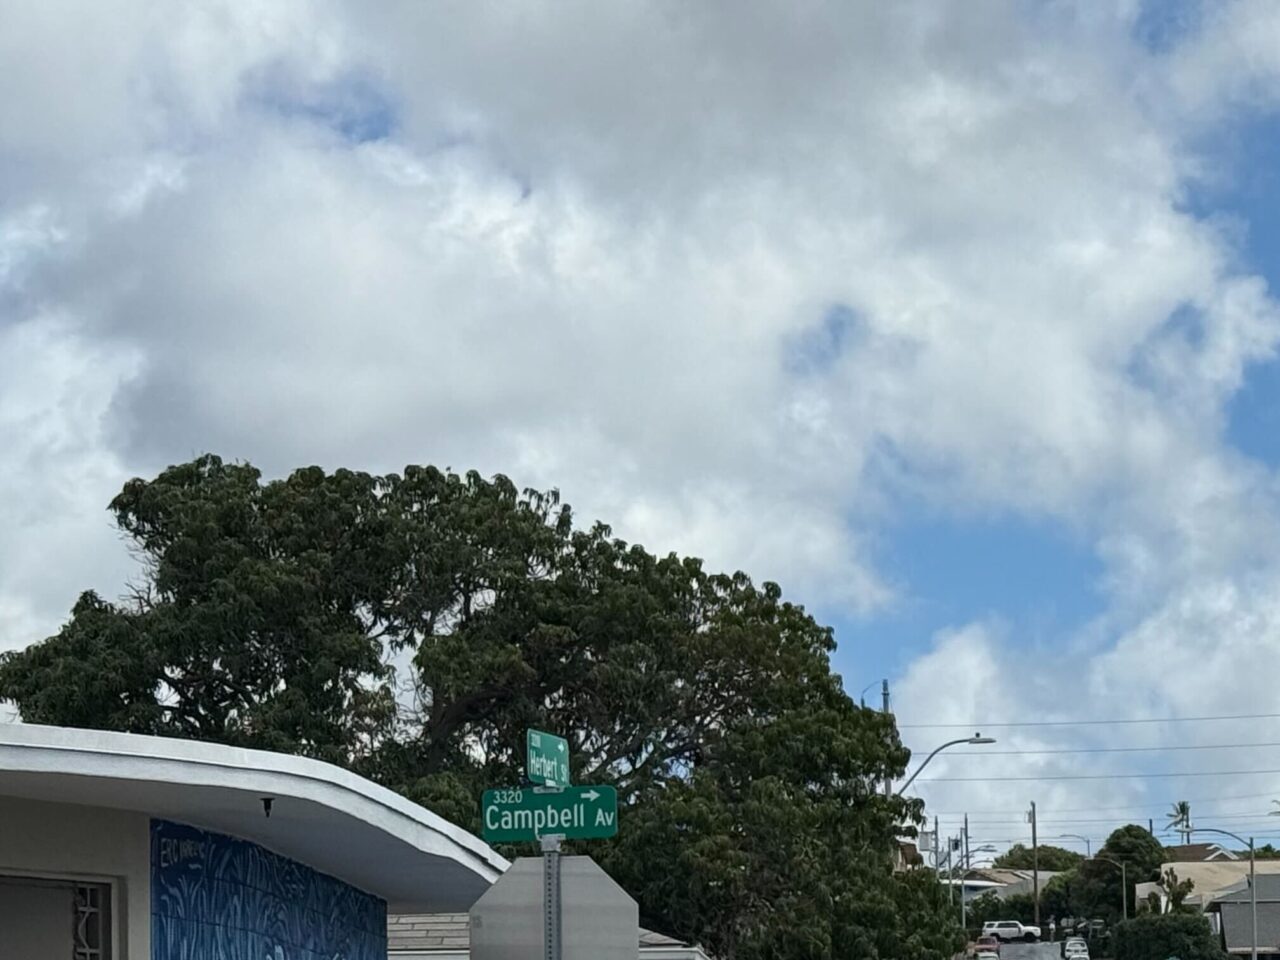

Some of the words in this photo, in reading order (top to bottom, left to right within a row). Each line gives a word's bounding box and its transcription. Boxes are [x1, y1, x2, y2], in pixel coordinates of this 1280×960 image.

[493, 790, 523, 804] 3320
[486, 803, 585, 834] Campbell
[594, 807, 615, 827] Av
